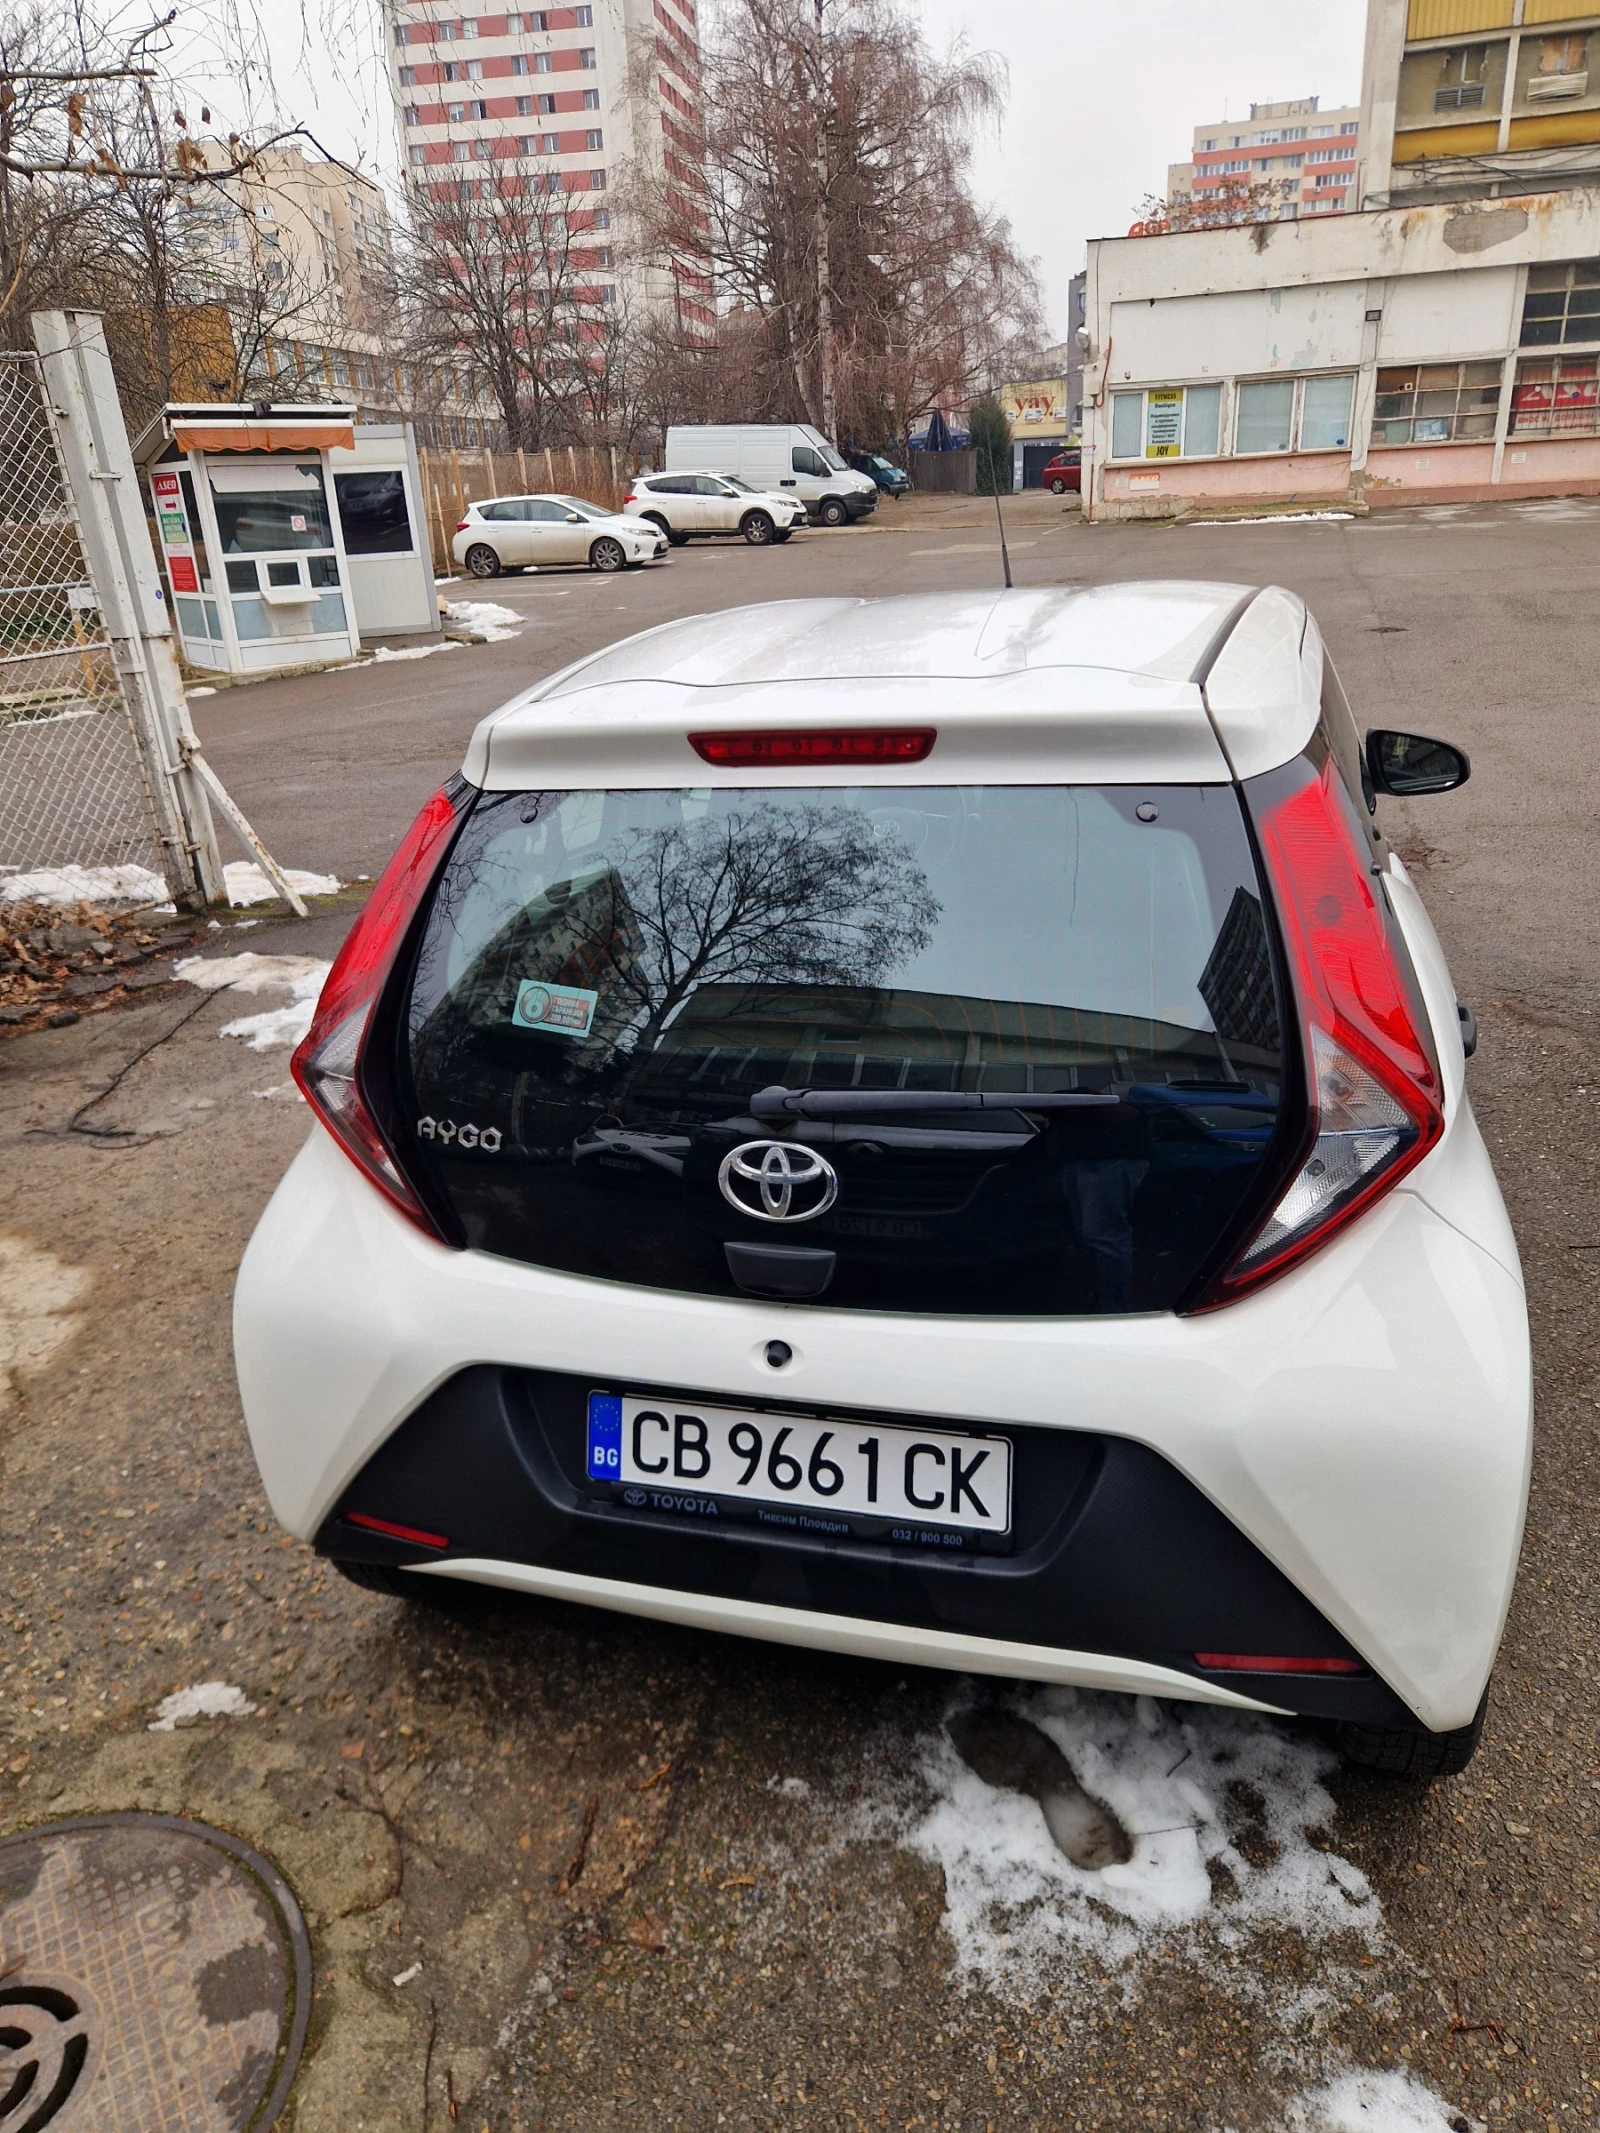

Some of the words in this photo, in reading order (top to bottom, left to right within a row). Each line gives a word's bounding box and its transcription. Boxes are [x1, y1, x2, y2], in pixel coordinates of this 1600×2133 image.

[1154, 393, 1177, 401] FITNESS
[1156, 446, 1169, 456] JOY
[157, 479, 177, 491] ASED
[551, 1005, 584, 1017] ГАРАНЦИЯ
[417, 1116, 503, 1153] AYGO
[593, 1446, 619, 1467] BG
[632, 1411, 711, 1479] CB
[727, 1422, 880, 1503] 9661
[903, 1443, 991, 1518] CK
[652, 1494, 718, 1516] TOYOTA
[757, 1510, 797, 1526] Тиксим
[799, 1515, 849, 1533] Пловдив
[892, 1529, 914, 1542] 032
[921, 1532, 940, 1544] 900
[942, 1534, 963, 1547] 500
